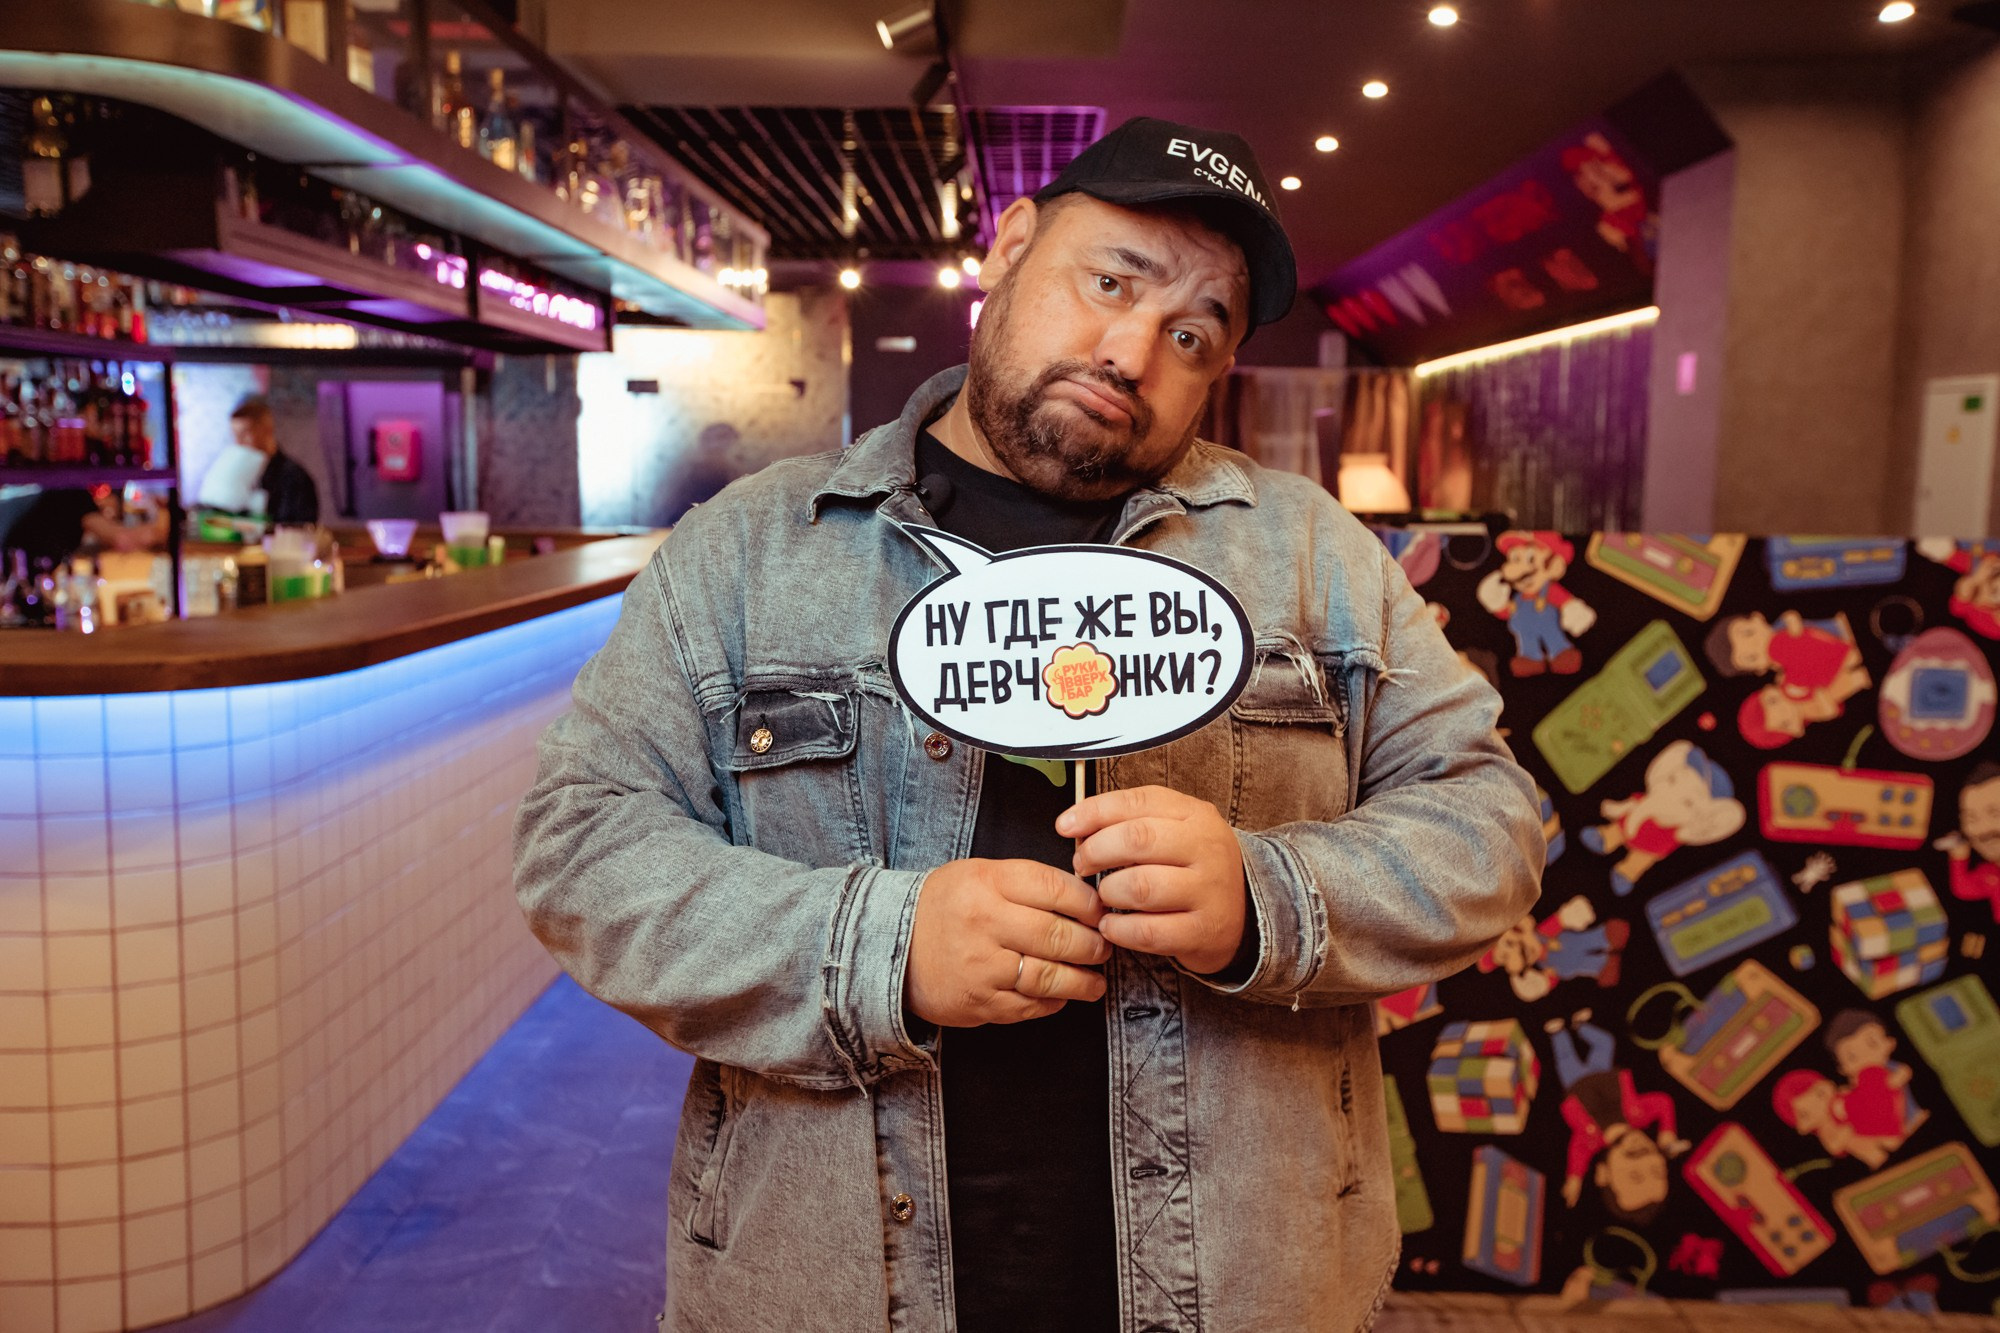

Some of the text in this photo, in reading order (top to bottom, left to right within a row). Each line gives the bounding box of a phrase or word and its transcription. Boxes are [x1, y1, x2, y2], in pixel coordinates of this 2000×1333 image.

[1167, 138, 1270, 211] EVGEN
[926, 590, 1222, 650] НУ ГДЕ ЖЕ ВЫ,
[1062, 660, 1098, 677] РУКИ
[1065, 670, 1108, 689] ВВЕРХ
[1067, 686, 1093, 700] БАР
